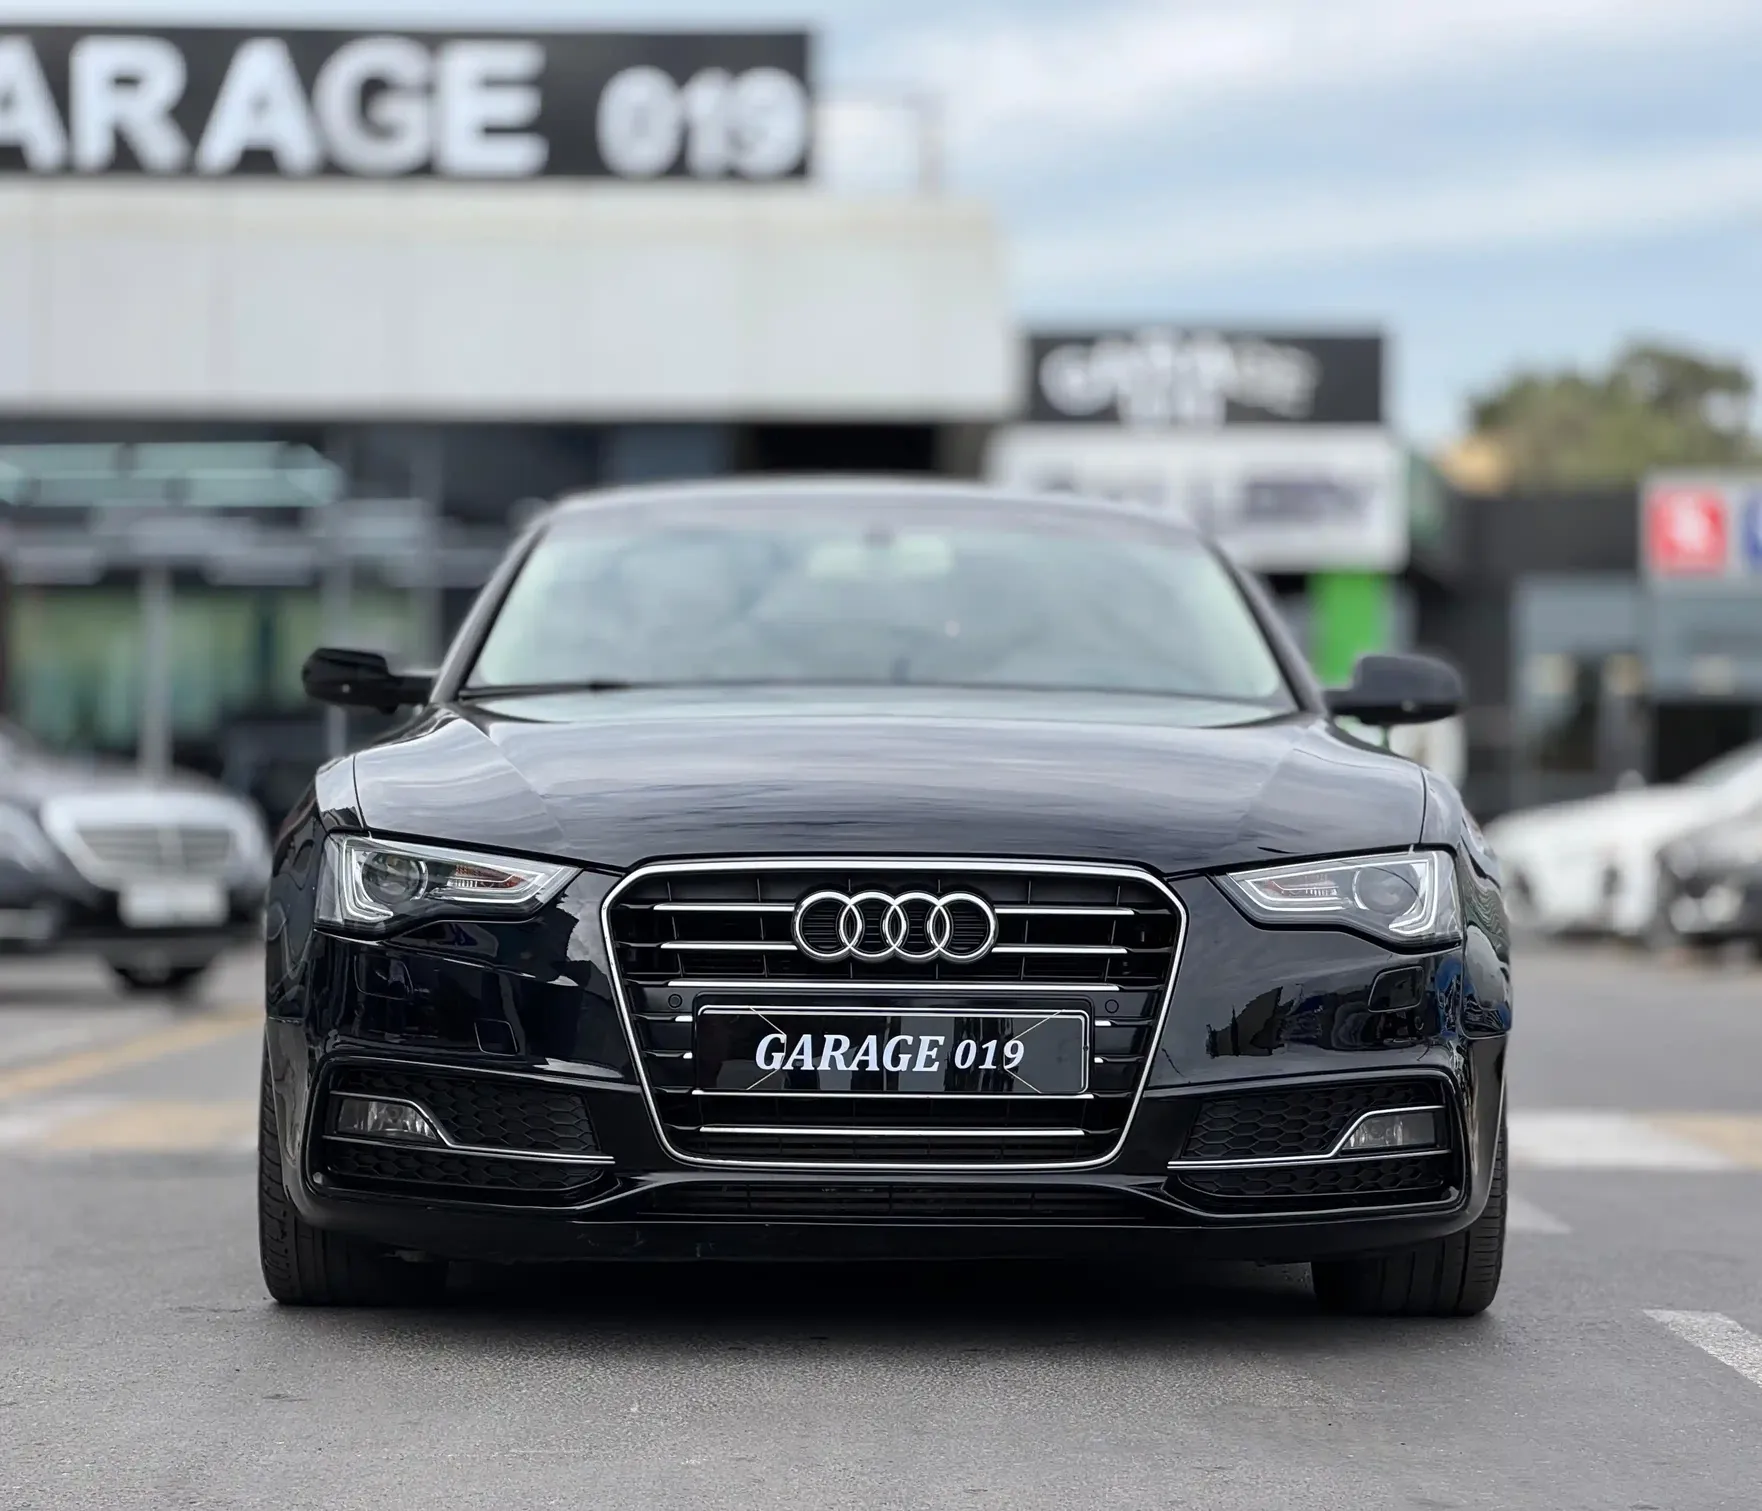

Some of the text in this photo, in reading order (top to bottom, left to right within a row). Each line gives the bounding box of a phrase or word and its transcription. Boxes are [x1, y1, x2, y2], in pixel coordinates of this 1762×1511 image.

[597, 65, 807, 179] 019
[755, 1033, 1025, 1072] GARAGE 019
